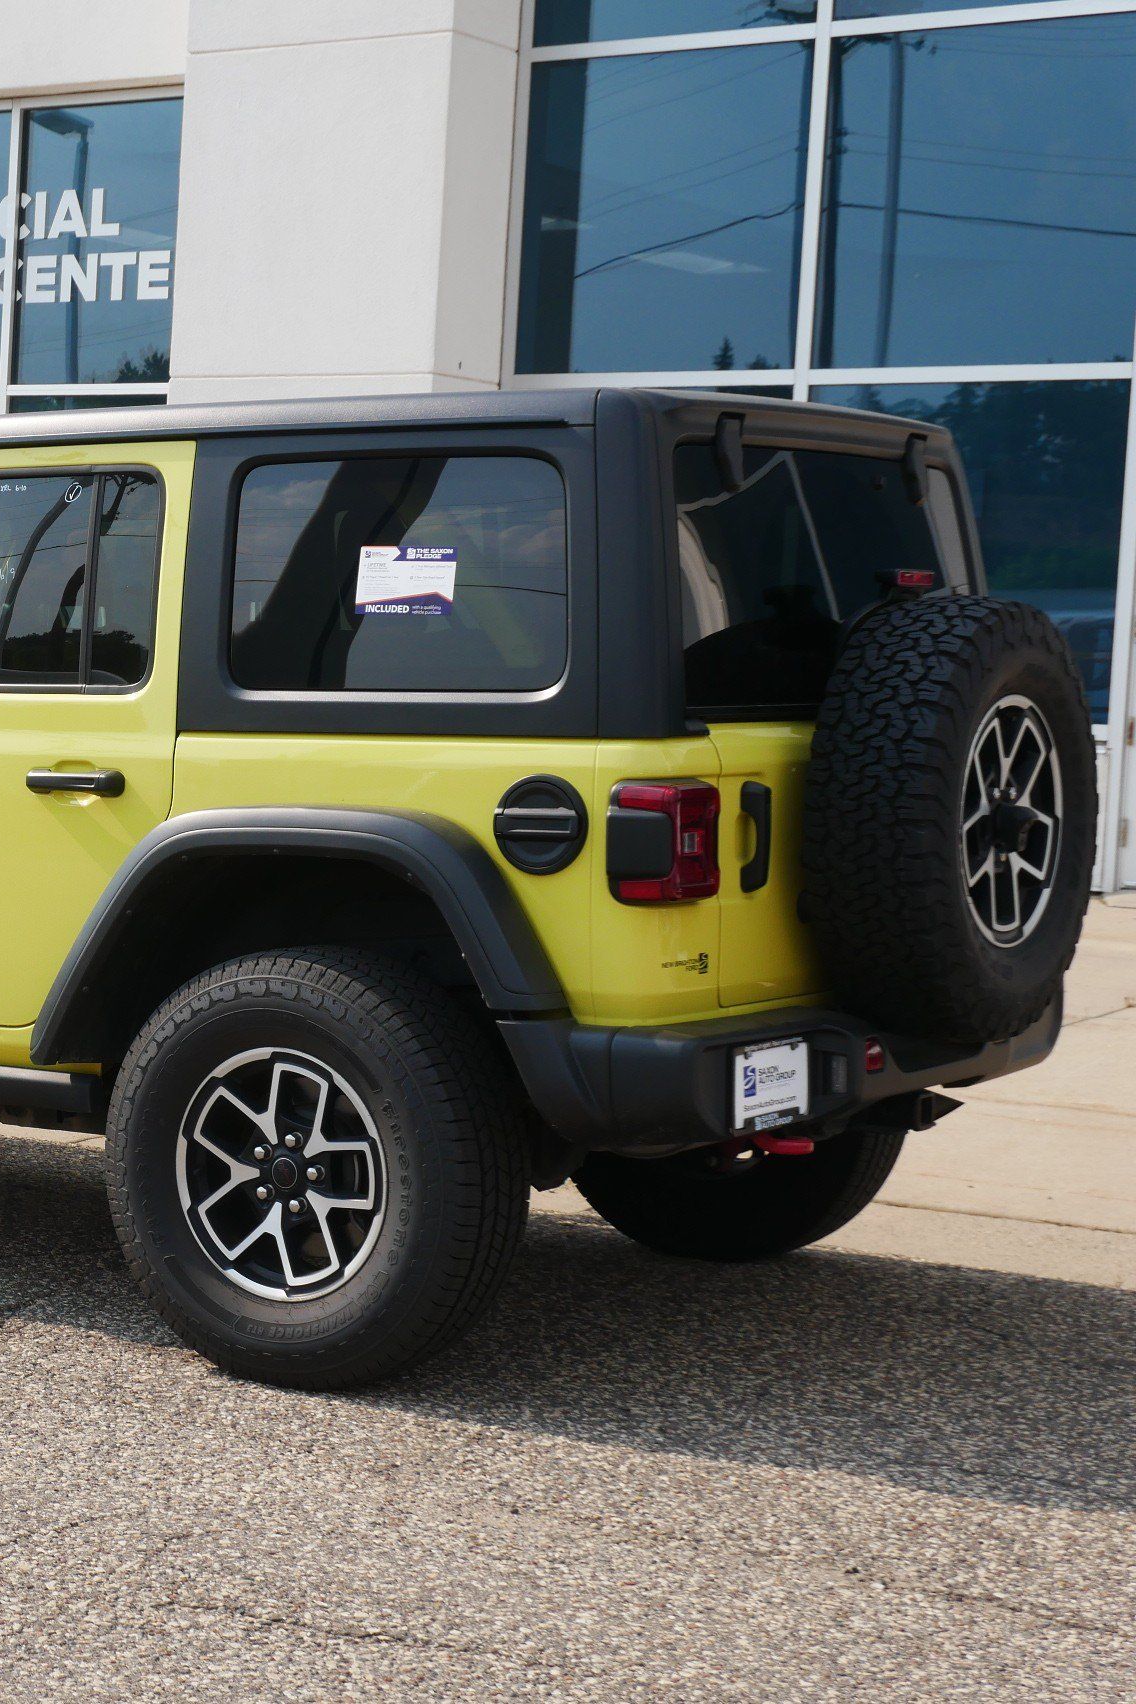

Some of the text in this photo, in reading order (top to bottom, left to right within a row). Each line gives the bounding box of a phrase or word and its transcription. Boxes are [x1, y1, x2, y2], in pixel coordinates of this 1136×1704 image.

[365, 604, 410, 613] INCLUDED
[758, 1065, 779, 1077] SAXON
[776, 1070, 796, 1081] GROUP
[381, 1099, 413, 1265] Firestone
[268, 1306, 353, 1339] TRANSFORCE
